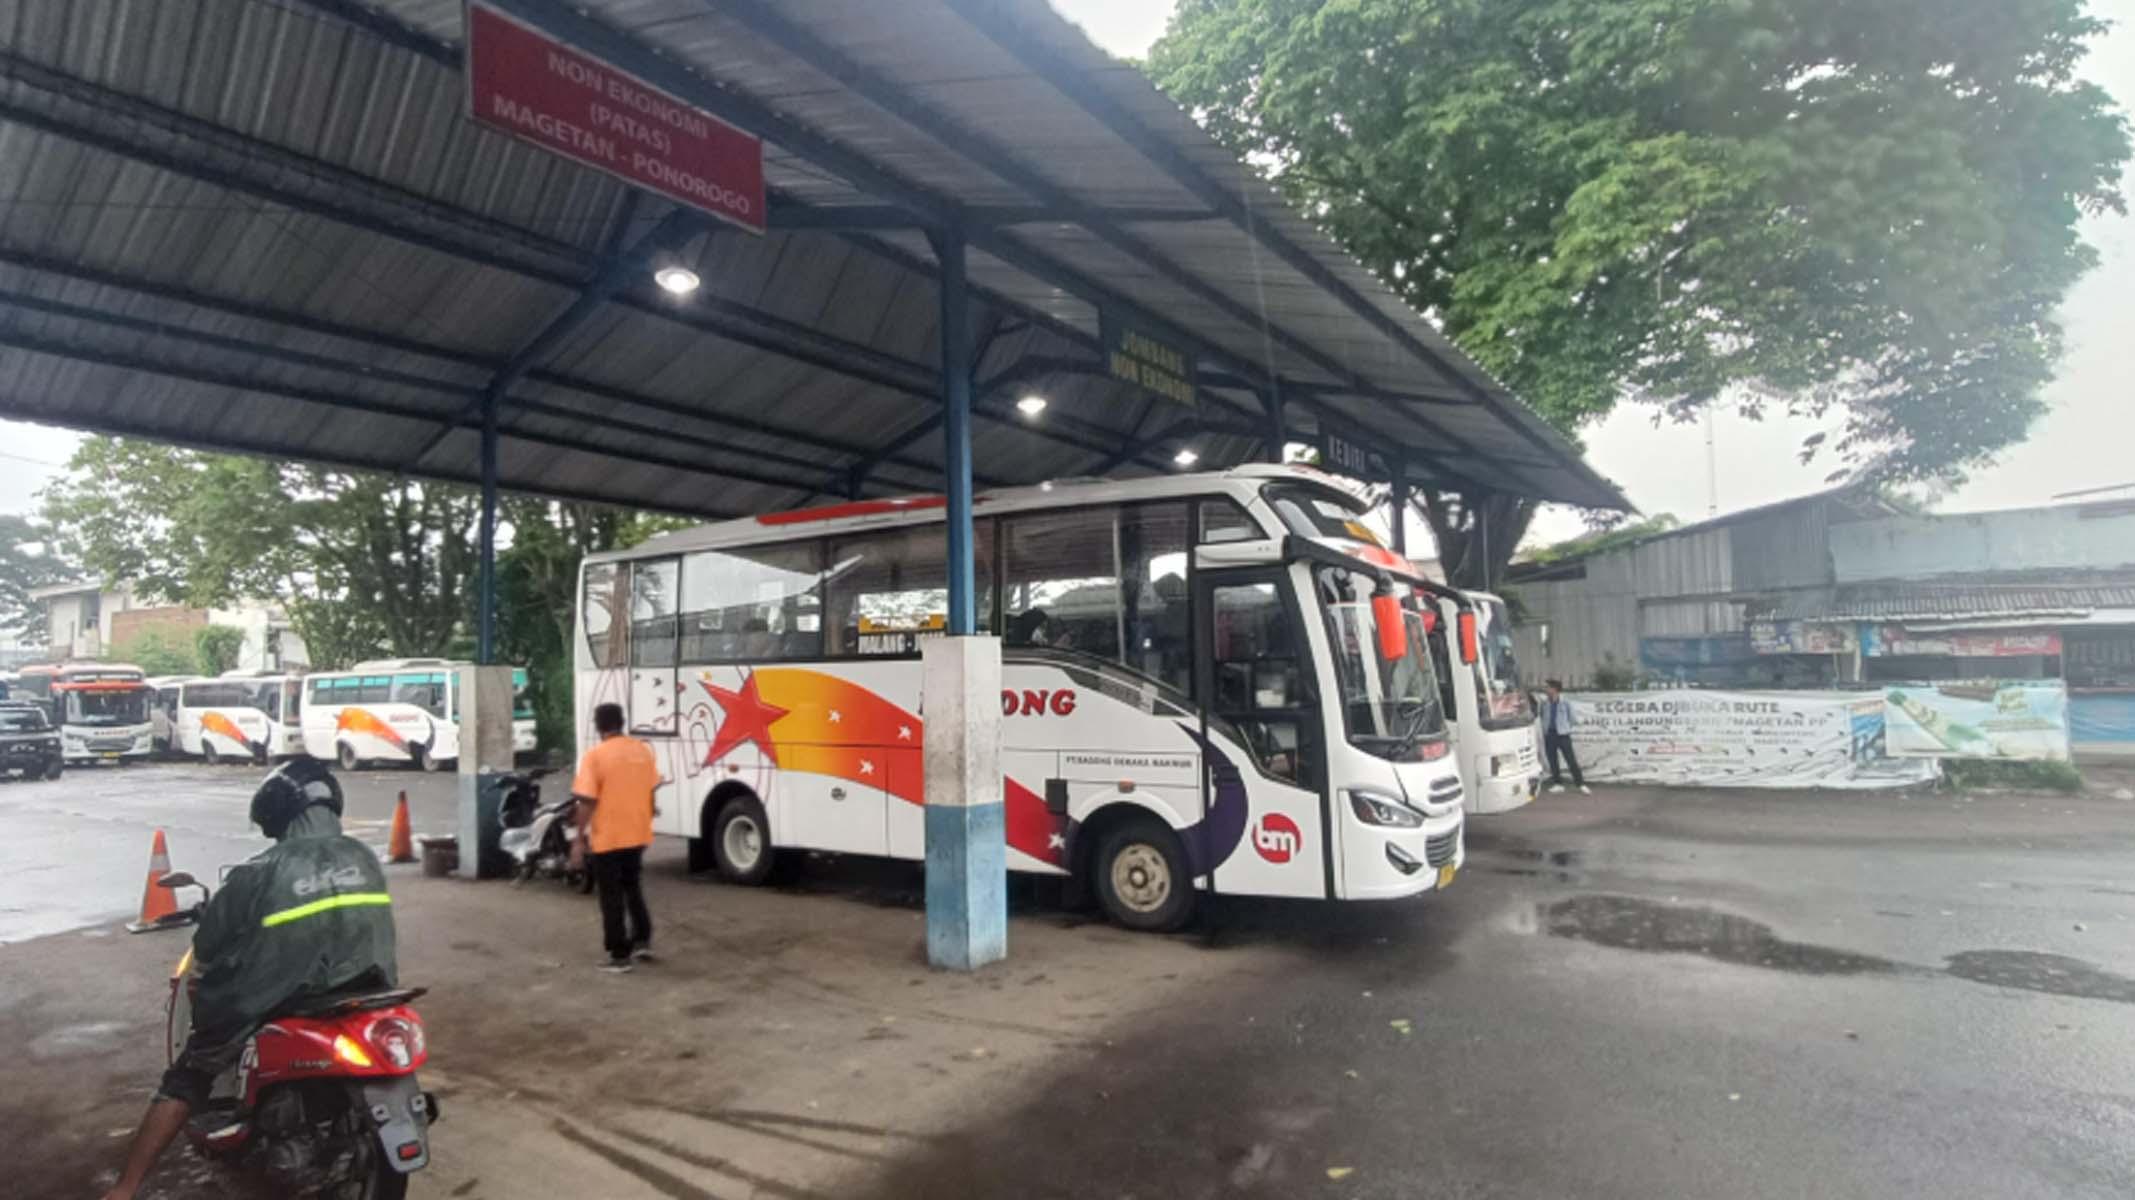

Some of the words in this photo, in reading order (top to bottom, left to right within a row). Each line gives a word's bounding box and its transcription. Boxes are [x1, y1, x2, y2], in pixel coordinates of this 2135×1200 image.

[549, 53, 602, 91] NON
[608, 79, 708, 139] EKONOMI
[590, 102, 671, 155] (PATAS)
[493, 95, 615, 162] MAGETAN
[633, 152, 751, 215] PONOROGO
[1594, 702, 1659, 713] SEGERA
[1733, 702, 1781, 713] RUTE
